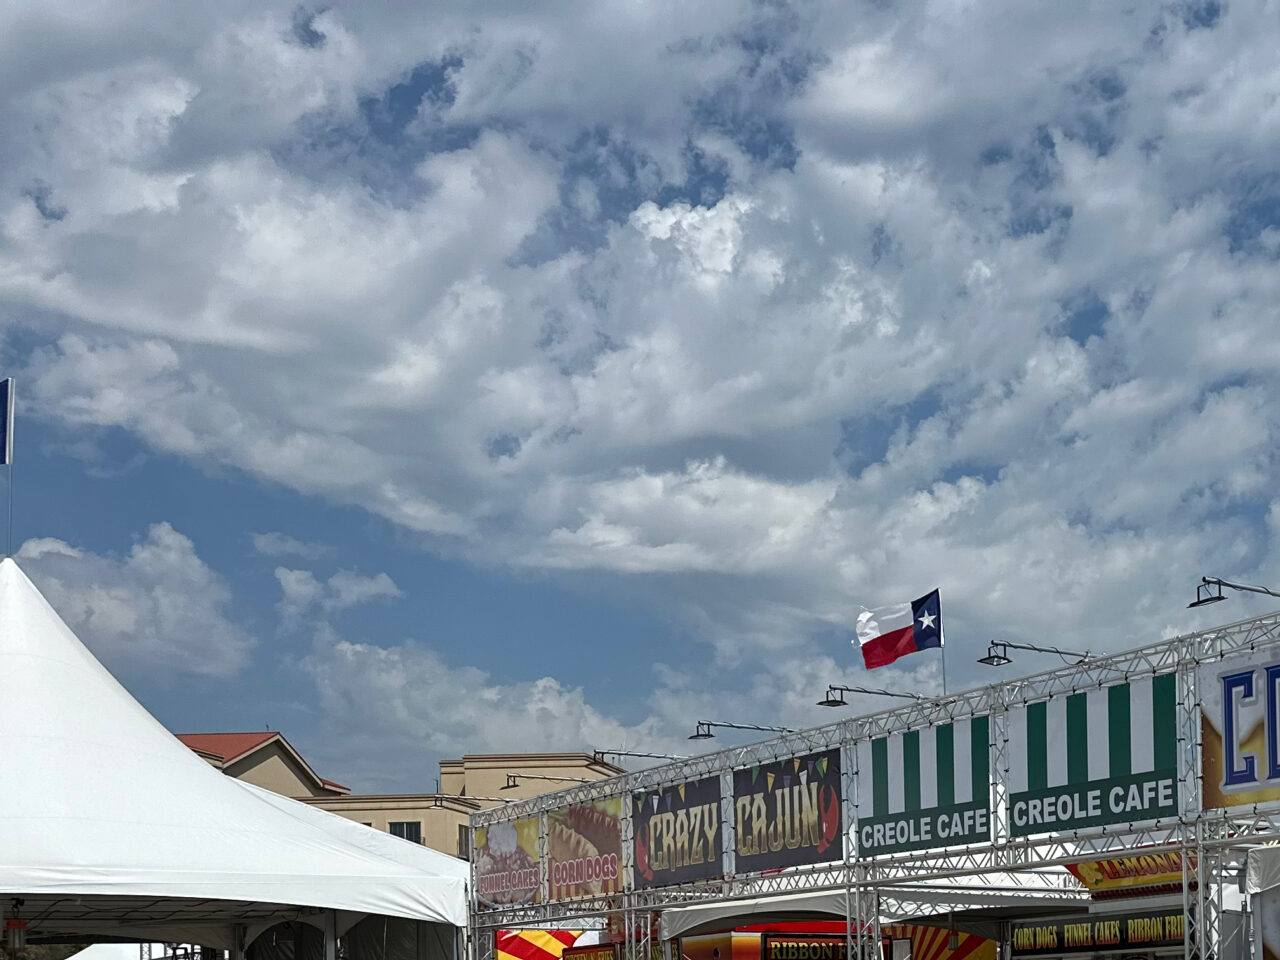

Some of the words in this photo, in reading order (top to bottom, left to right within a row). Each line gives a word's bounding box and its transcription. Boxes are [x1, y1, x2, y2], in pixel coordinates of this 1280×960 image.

[1013, 789, 1101, 827] CREOLE
[1108, 778, 1174, 814] CAFE
[649, 802, 719, 872] CRAZY
[735, 781, 820, 857] CAJUN
[861, 816, 932, 848] CREOLE
[937, 808, 988, 839] CAFE
[479, 871, 510, 895] FUNNEL
[511, 867, 540, 891] CAKES
[553, 858, 585, 887] CORN
[585, 852, 618, 880] DOGS
[1096, 850, 1198, 879] LEMONA
[1013, 927, 1035, 950] CORN
[1036, 925, 1058, 948] DOGS
[1064, 922, 1093, 947] FUNNEL
[1094, 919, 1121, 945] CAKES
[1127, 916, 1163, 943] RIBBON
[1164, 914, 1185, 941] FRI
[770, 941, 833, 960] RIBBON
